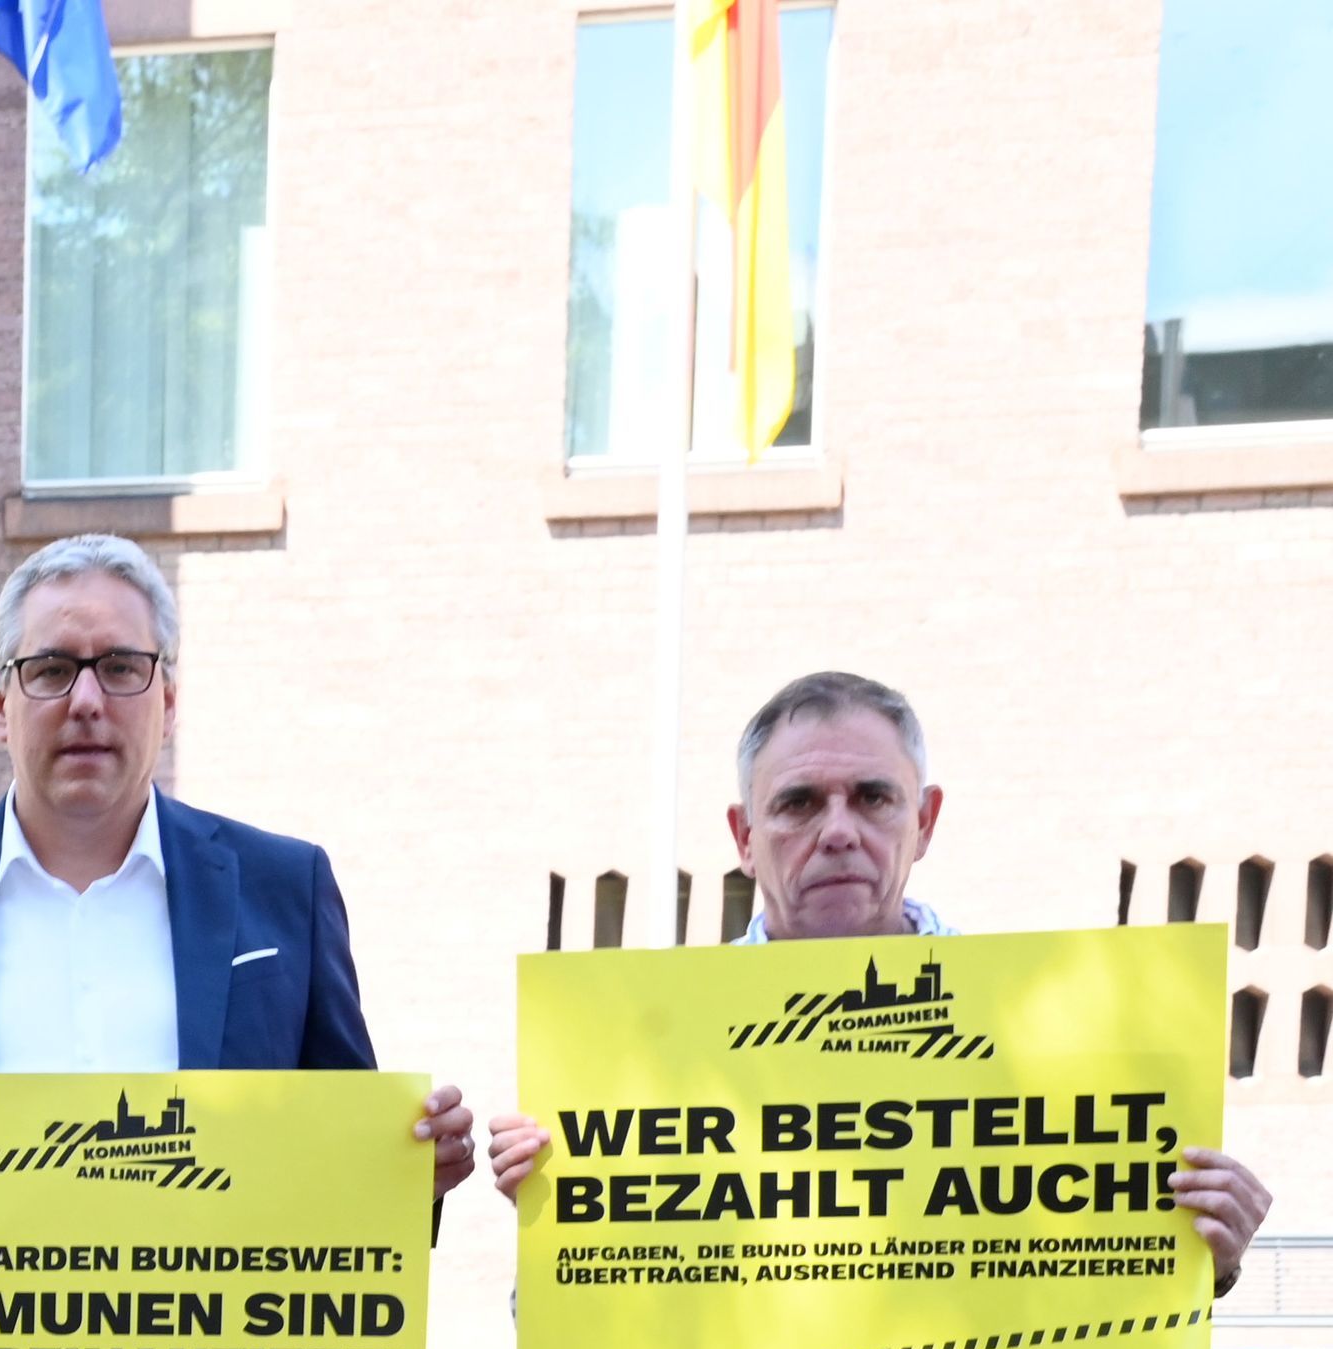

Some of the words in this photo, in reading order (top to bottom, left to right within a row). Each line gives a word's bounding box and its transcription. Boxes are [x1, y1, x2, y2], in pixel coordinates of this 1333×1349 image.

[828, 1006, 949, 1033] KOMMUNEN
[820, 1039, 852, 1052] AM
[857, 1040, 910, 1053] LIMIT
[558, 1106, 736, 1157] WER
[761, 1092, 1178, 1155] BESTELLT,
[83, 1140, 191, 1160] KOMMUNEN
[76, 1166, 105, 1179] AM
[109, 1168, 157, 1182] LIMIT
[556, 1168, 905, 1224] BEZAHLT
[923, 1160, 1177, 1216] AUCH!
[131, 1246, 403, 1273] BUNDESWEIT:
[557, 1245, 685, 1264] AUFGABEN,
[697, 1244, 735, 1259] DIE
[742, 1244, 806, 1258] BUND
[814, 1242, 863, 1256] UND
[870, 1237, 965, 1256] LÄNDER
[972, 1239, 1021, 1254] DEN
[1028, 1235, 1176, 1253] KOMMUNEN
[556, 1262, 748, 1285] ÜBERTRAGEN,
[755, 1261, 955, 1281] AUSREICHEND
[970, 1257, 1175, 1279] FINANZIEREN!
[243, 1292, 405, 1337] SIND
